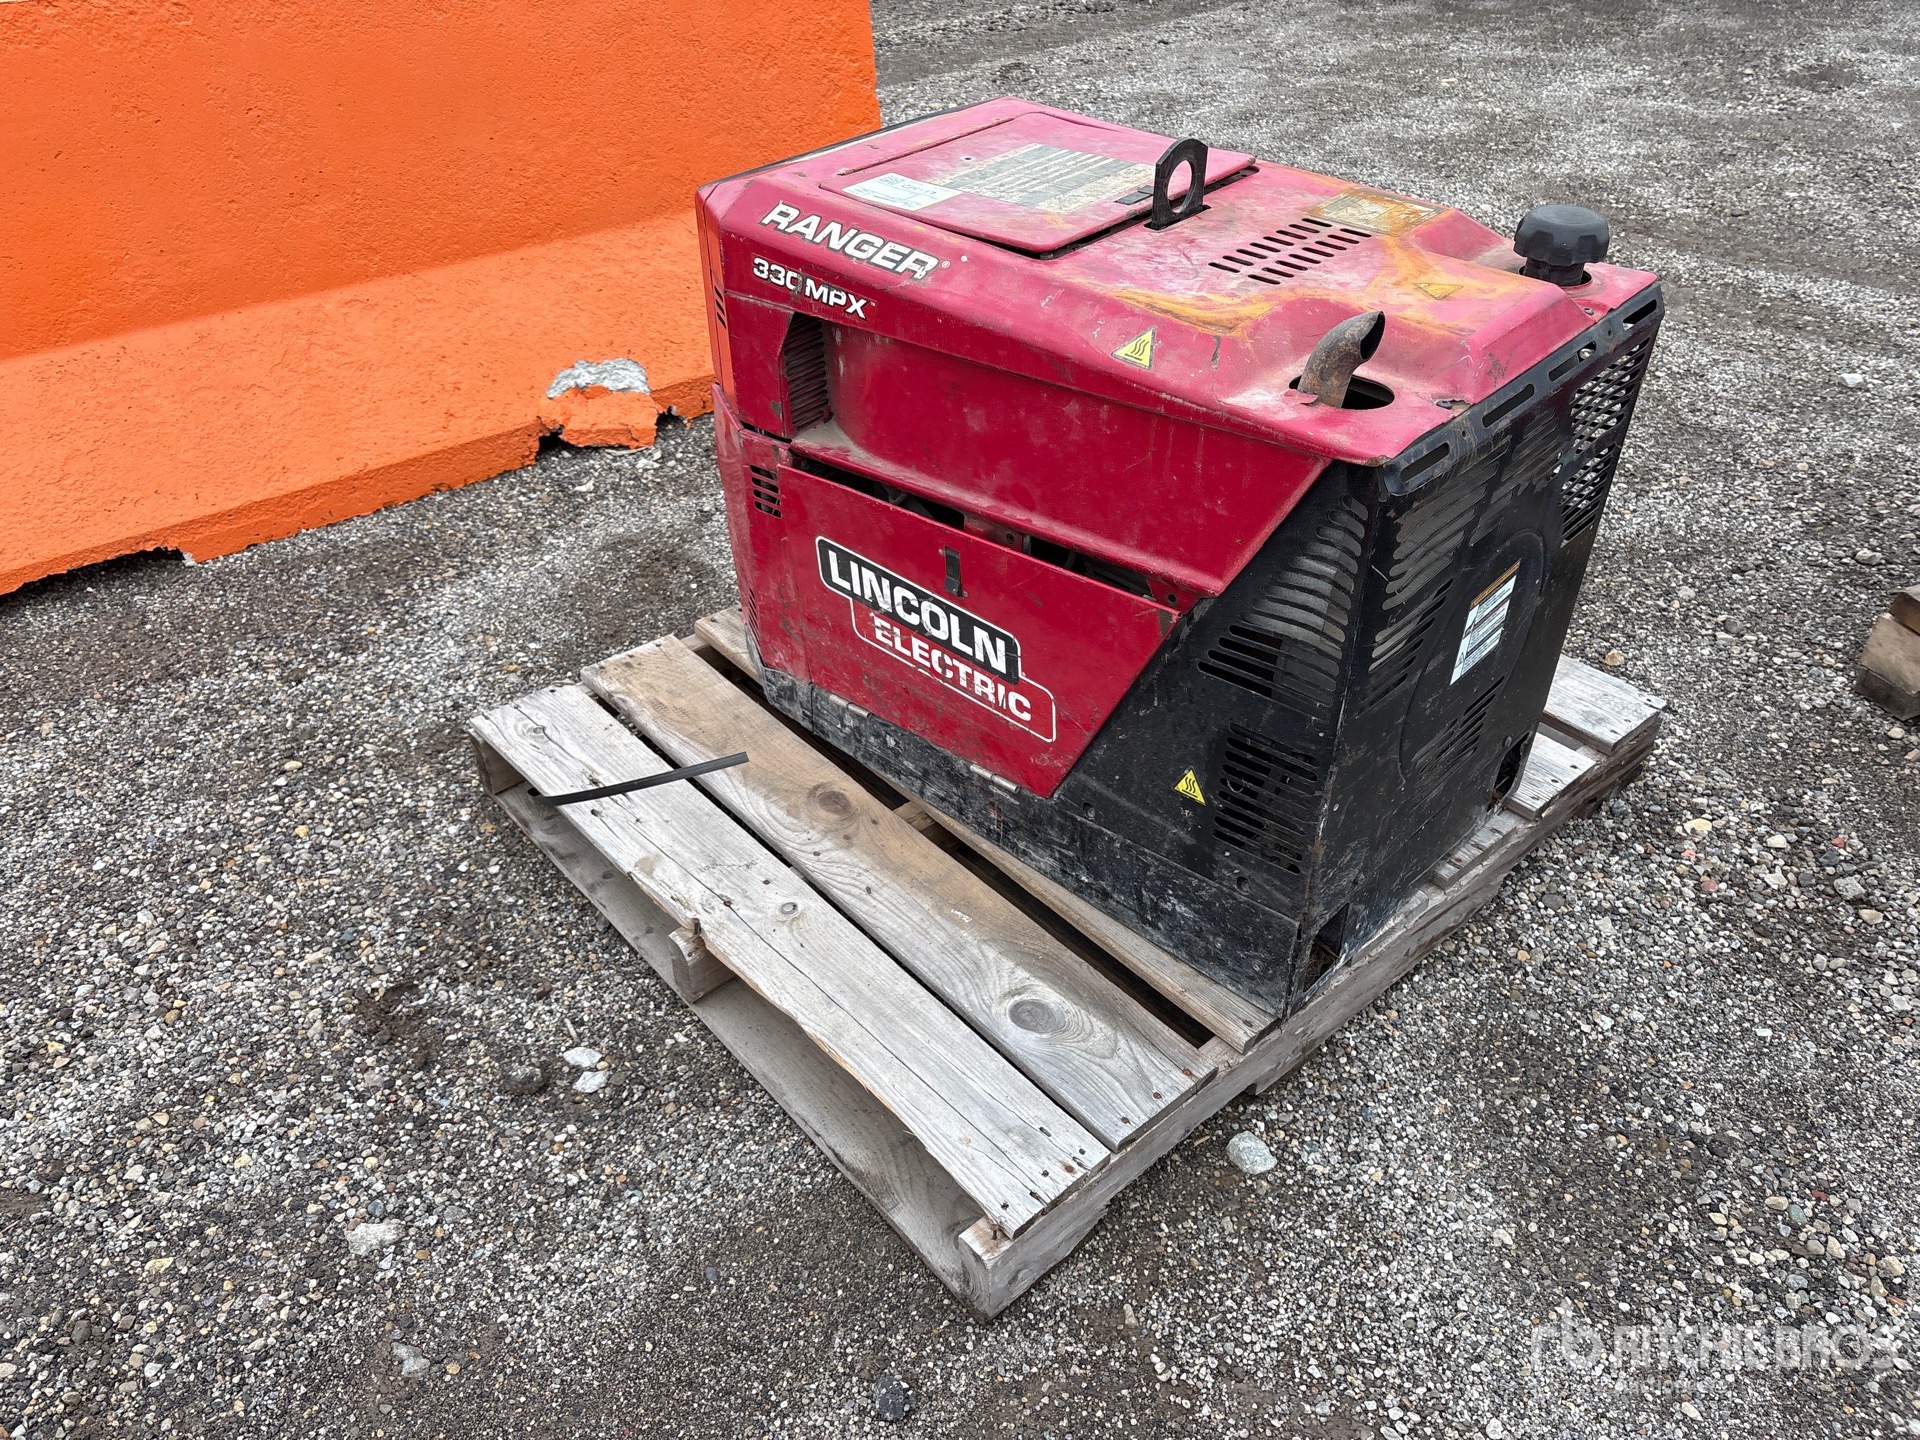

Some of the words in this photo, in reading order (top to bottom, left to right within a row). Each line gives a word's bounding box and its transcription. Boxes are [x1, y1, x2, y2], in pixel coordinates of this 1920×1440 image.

[752, 256, 803, 293] 330
[804, 279, 868, 320] MPX
[761, 204, 939, 280] RANGER
[828, 550, 1007, 675] LINCOLN
[872, 613, 1032, 722] ELECTRIC
